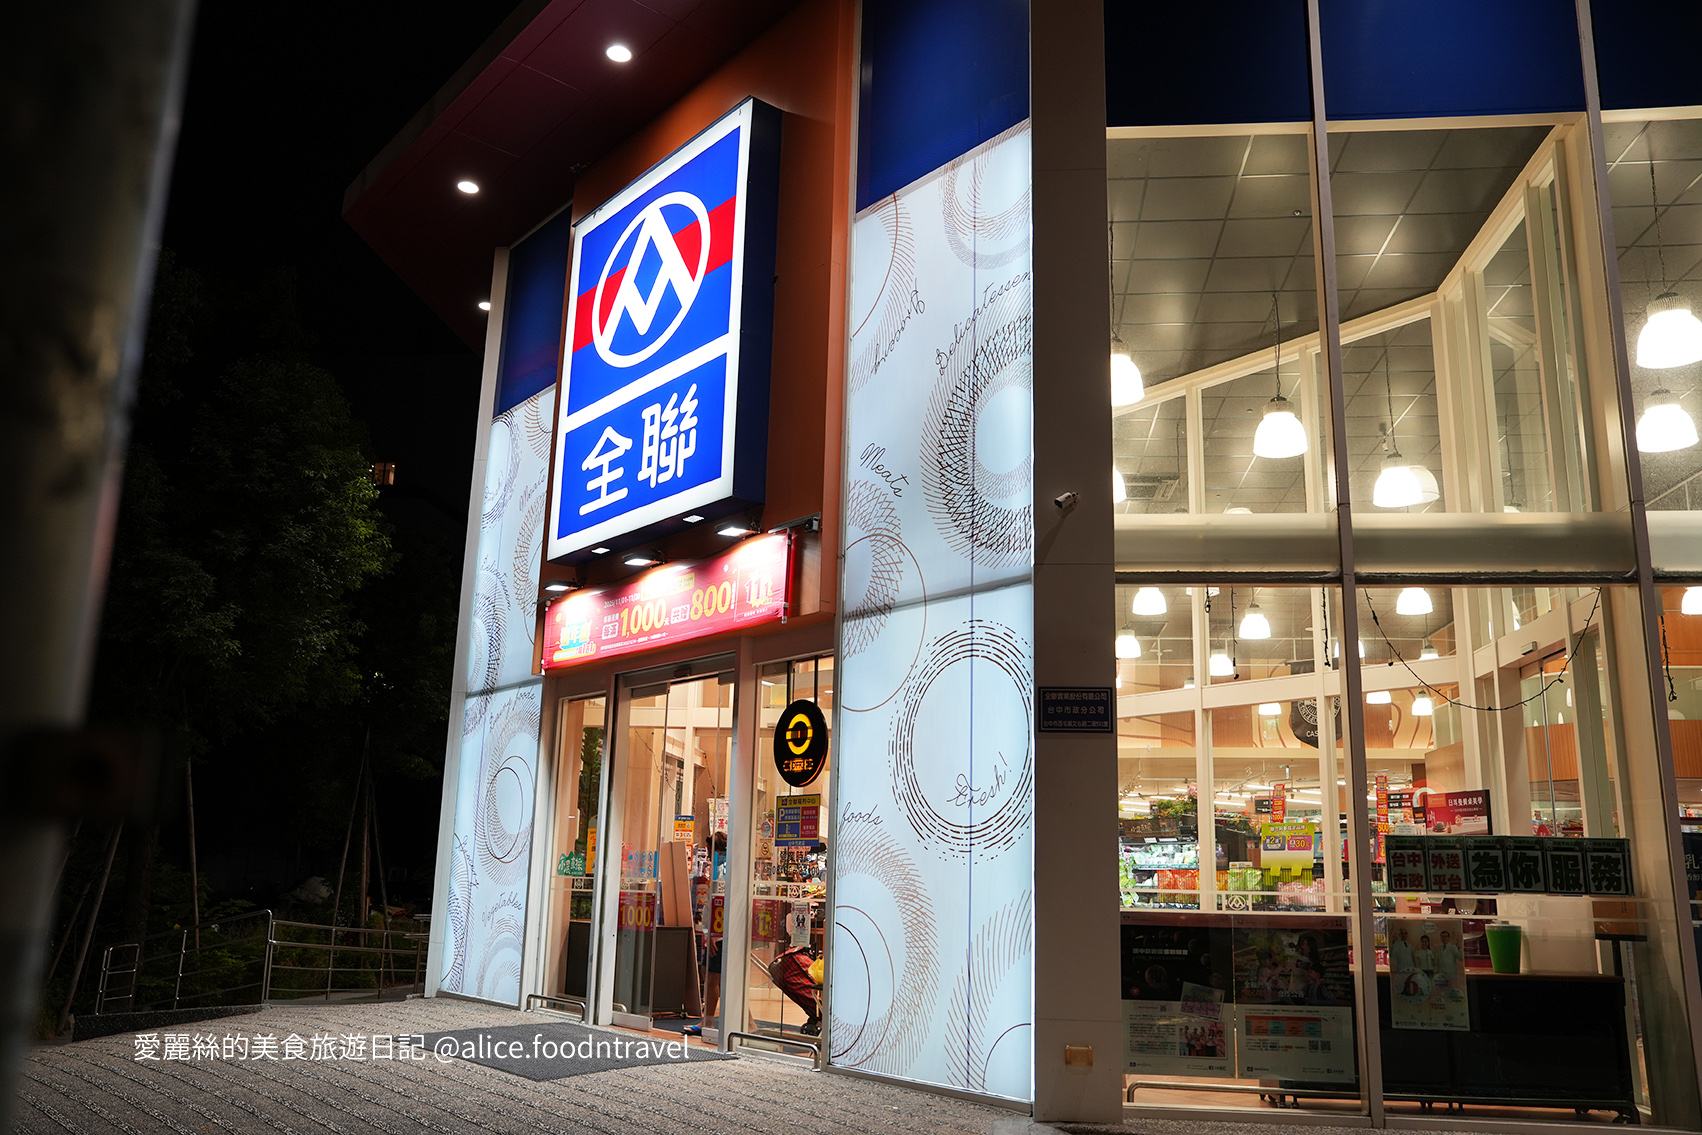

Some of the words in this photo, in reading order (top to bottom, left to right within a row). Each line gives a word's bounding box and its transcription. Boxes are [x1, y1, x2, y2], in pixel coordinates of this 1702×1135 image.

[579, 383, 699, 516] 全聯
[620, 599, 667, 638] 1,000
[690, 581, 732, 621] 800
[1047, 705, 1105, 715] 台中市政分公司
[779, 808, 786, 821] P
[1391, 852, 1422, 867] 台中
[1431, 853, 1461, 869] 外送
[1684, 853, 1702, 869] 乳
[1471, 850, 1622, 893] 為你服務
[1393, 873, 1424, 889] 市政
[1432, 874, 1462, 891] 平台
